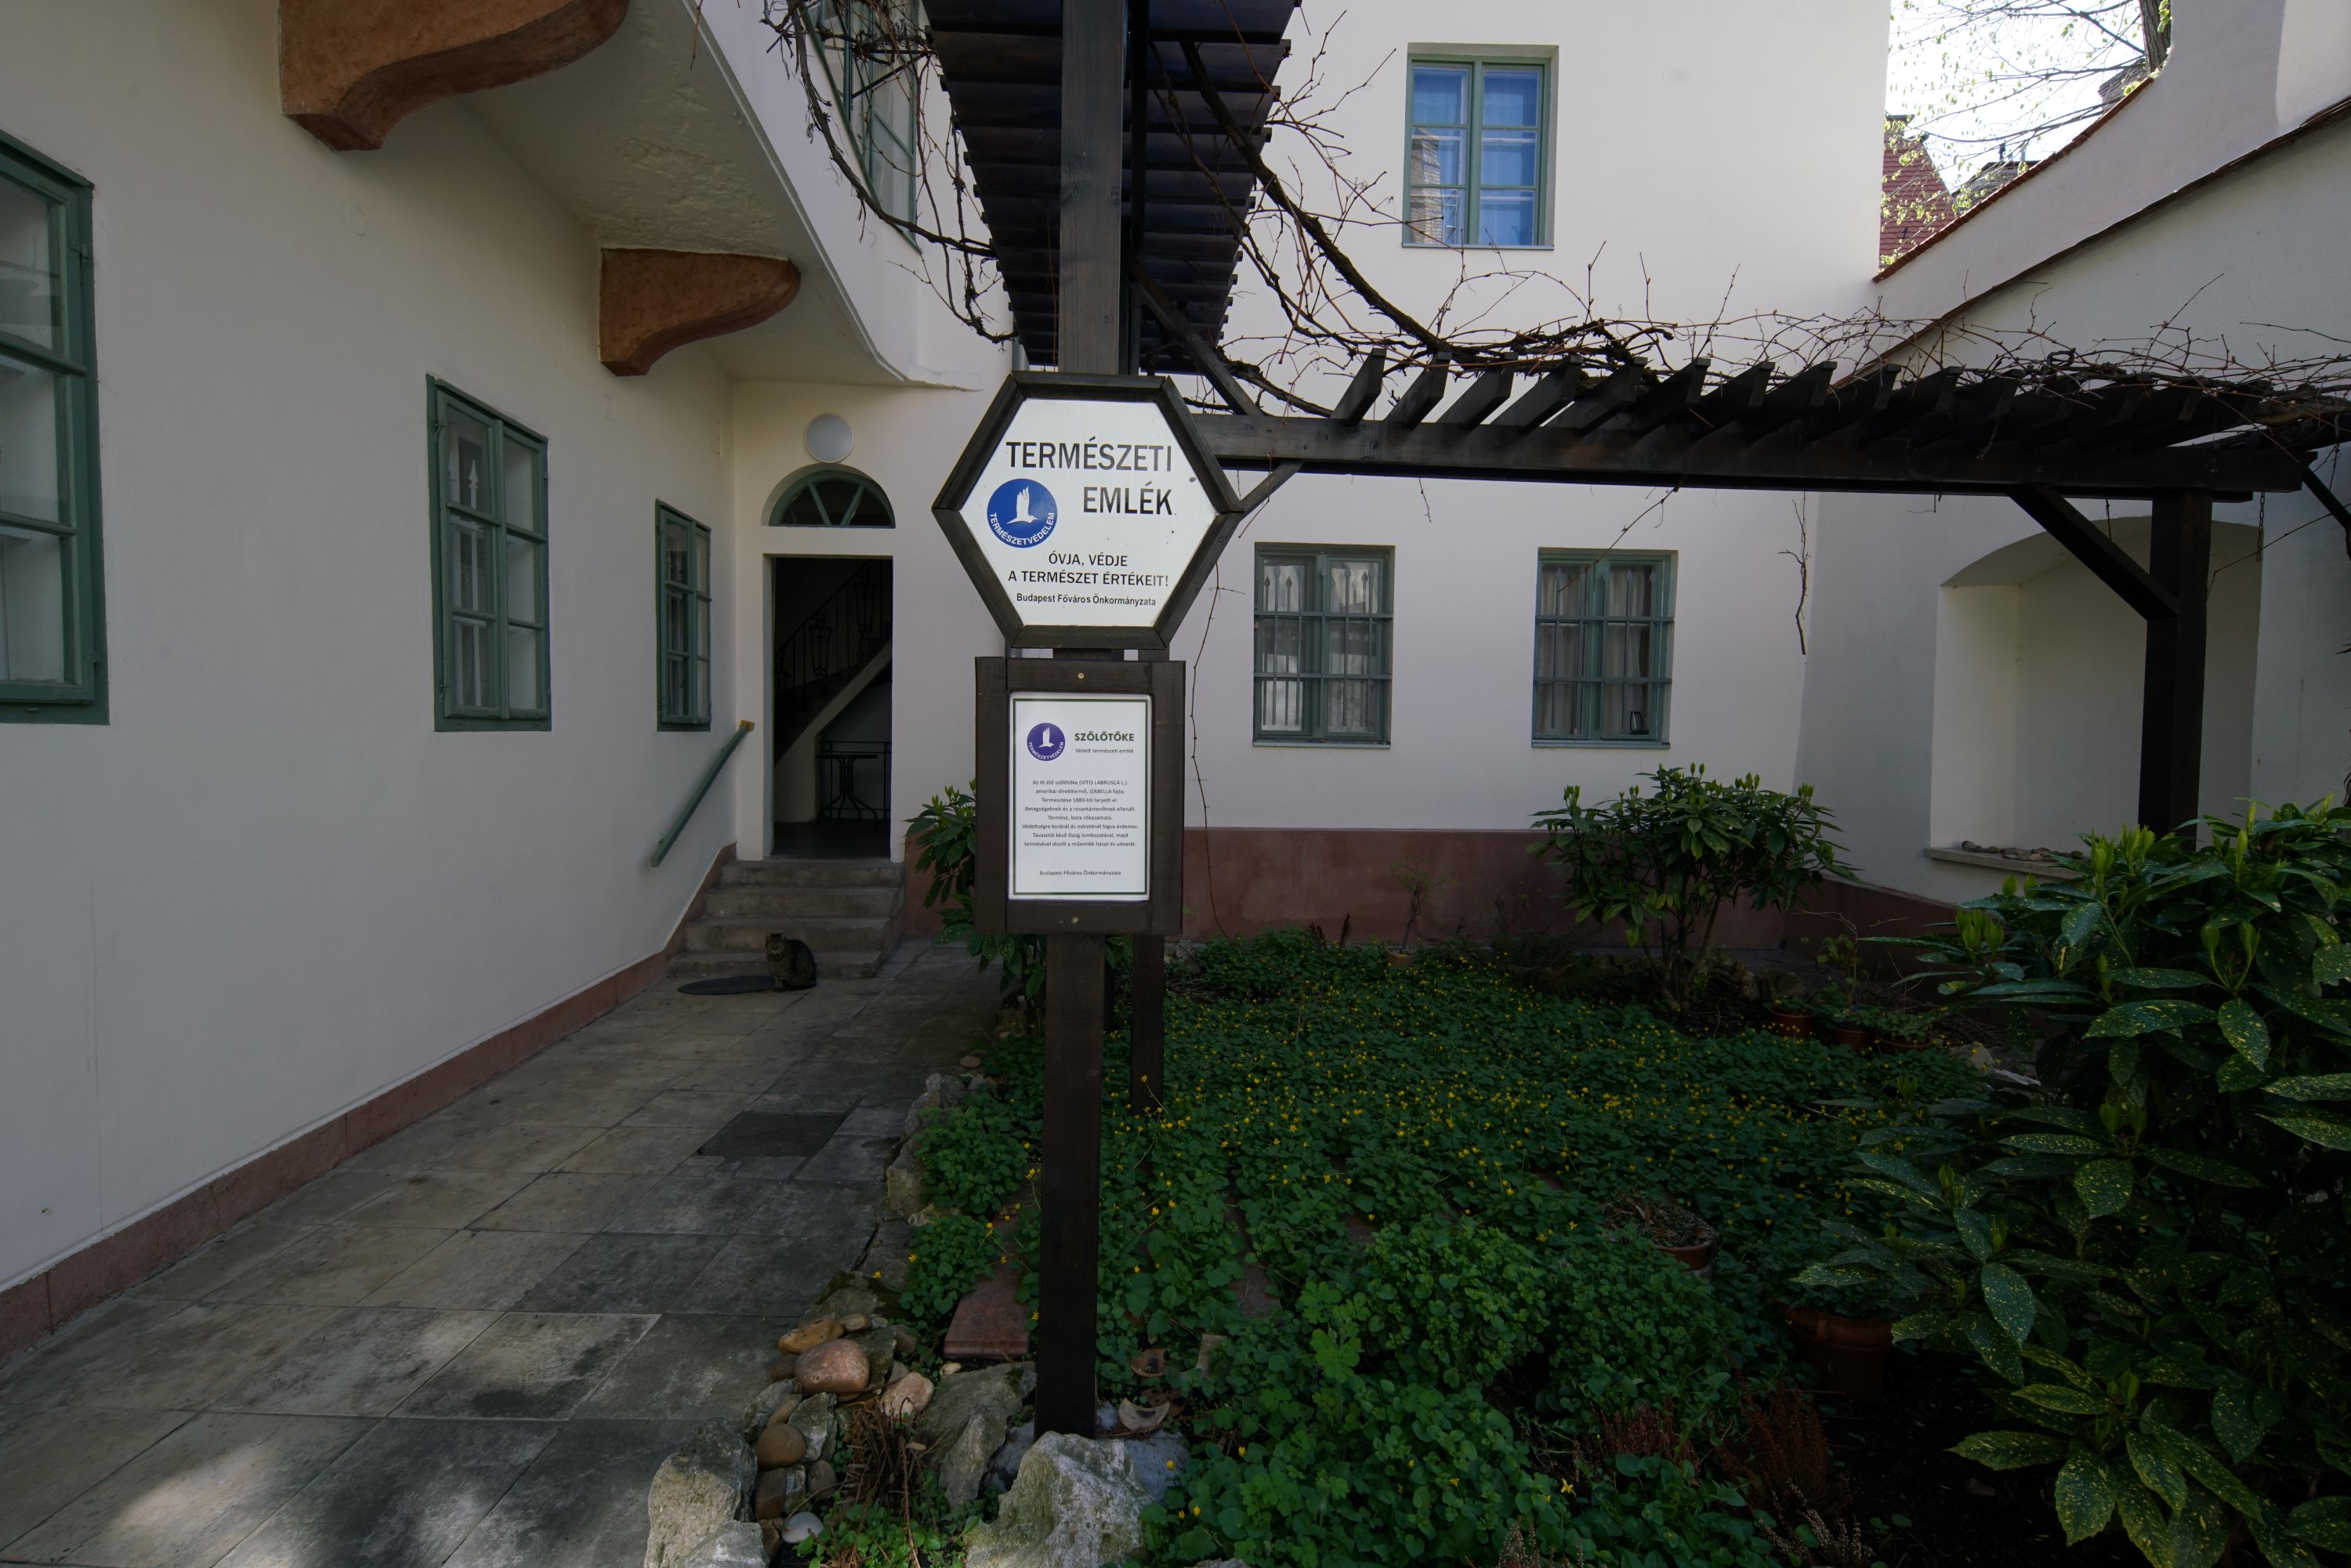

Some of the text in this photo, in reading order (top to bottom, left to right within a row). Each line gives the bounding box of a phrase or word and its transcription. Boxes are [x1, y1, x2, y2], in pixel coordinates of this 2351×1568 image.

[1006, 436, 1172, 472] TERMÉSZETI
[1083, 480, 1173, 516] EMLÉK
[990, 512, 1055, 545] TERMÉSZETVÉDELEM
[1049, 550, 1128, 567] ÓVJA, VÉDJE
[1008, 570, 1168, 586] A TERMÉSZET ÉRTÉKEIT!
[1016, 593, 1156, 607] Budapest Főváros Önkormányzata
[1074, 730, 1135, 741] SZŐLŐTŐKE
[1028, 741, 1064, 760] TERMÉSZETVÉDELEM
